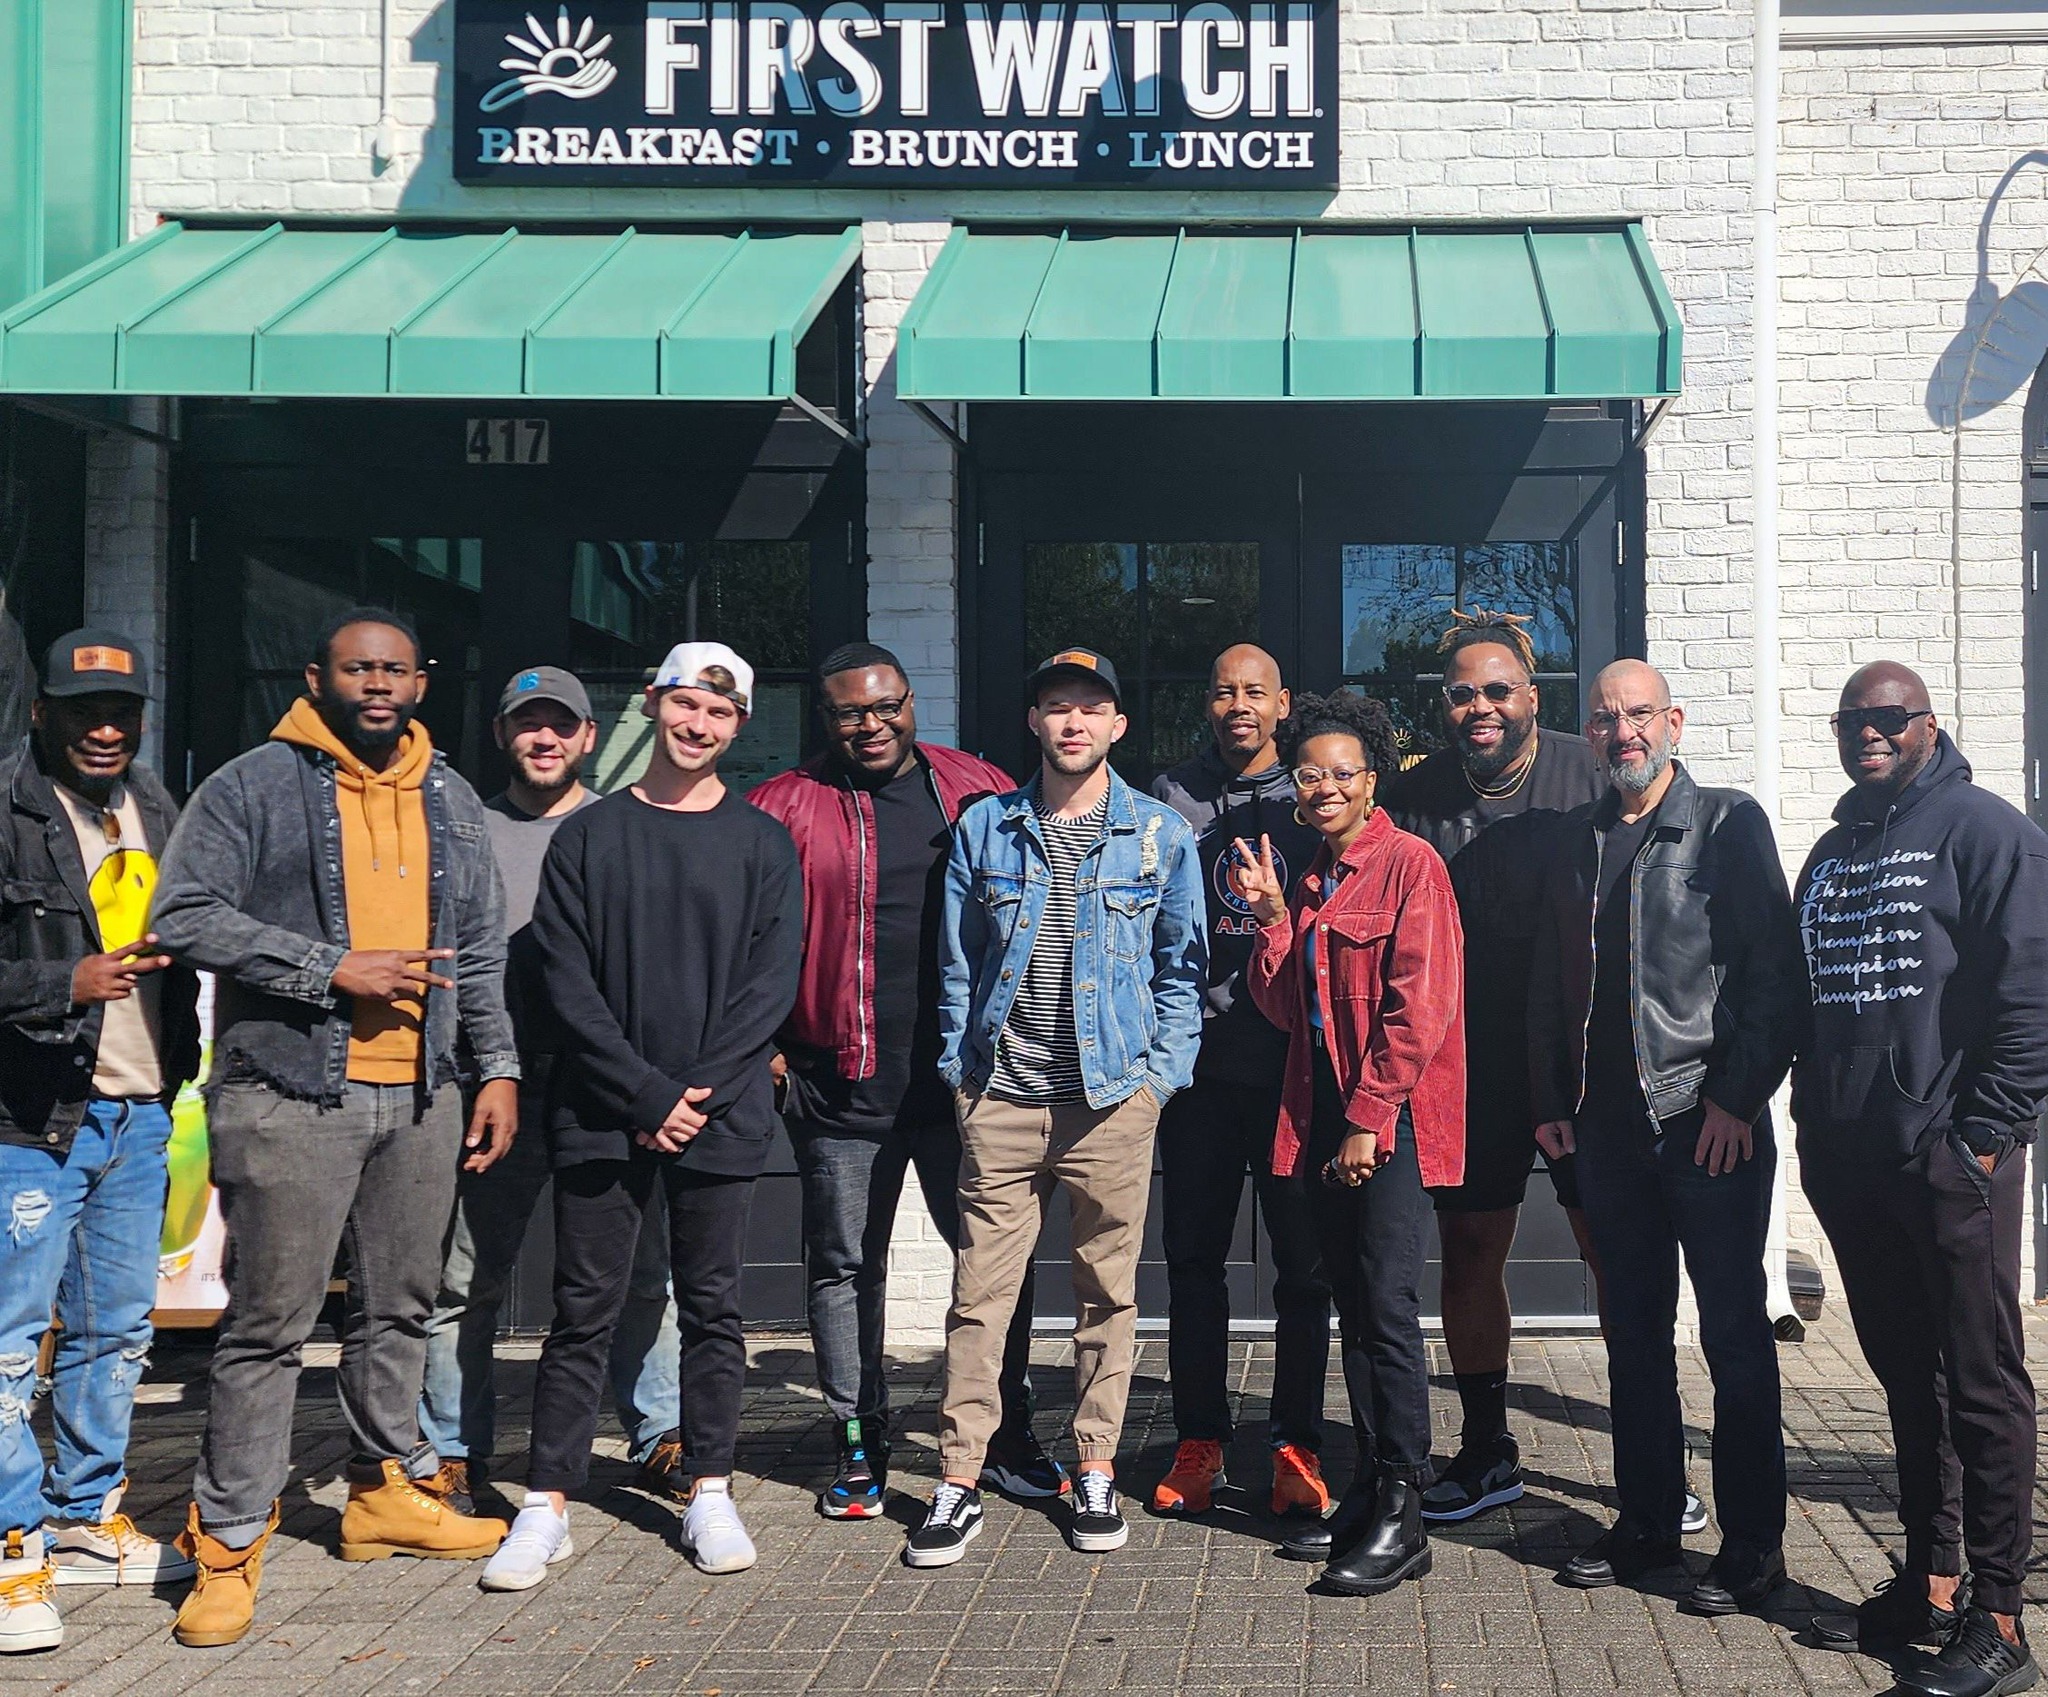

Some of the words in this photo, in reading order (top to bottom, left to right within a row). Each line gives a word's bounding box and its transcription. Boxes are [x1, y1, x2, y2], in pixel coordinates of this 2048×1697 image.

[645, 2, 946, 117] FIRST
[964, 2, 1314, 119] WATCH
[477, 127, 799, 165] BREAKFAST
[848, 129, 1079, 168] BRUNCH
[1129, 131, 1314, 168] LUNCH
[468, 420, 546, 462] 417
[1800, 898, 1923, 930] Champion
[1801, 926, 1922, 957] Champion
[1806, 954, 1923, 985] Champion
